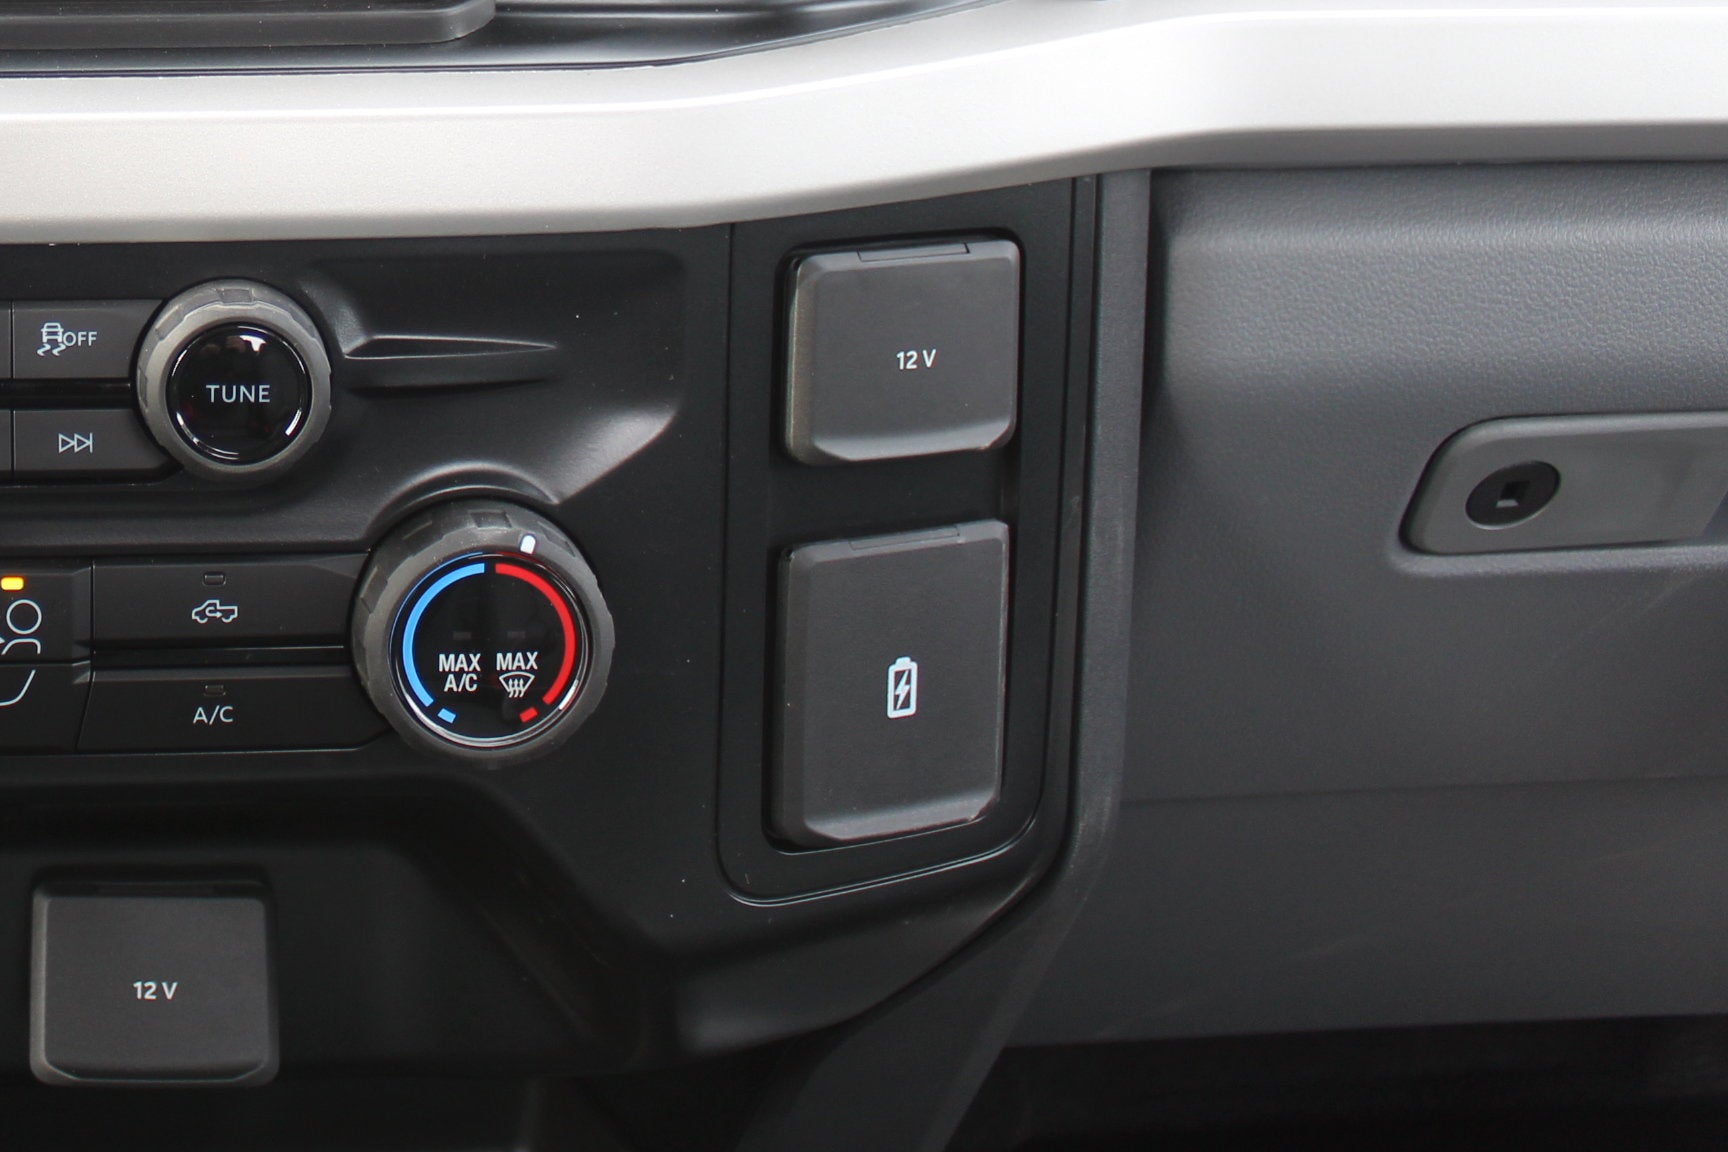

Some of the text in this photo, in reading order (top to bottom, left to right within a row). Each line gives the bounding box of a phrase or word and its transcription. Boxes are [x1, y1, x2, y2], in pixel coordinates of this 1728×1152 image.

[62, 331, 98, 349] OFF
[896, 348, 937, 370] 12 V
[205, 384, 271, 403] TUNE
[438, 653, 481, 673] MAX
[496, 651, 539, 671] MAX
[443, 674, 478, 692] A/C
[192, 705, 234, 724] A/C
[133, 981, 178, 1000] 12 V
